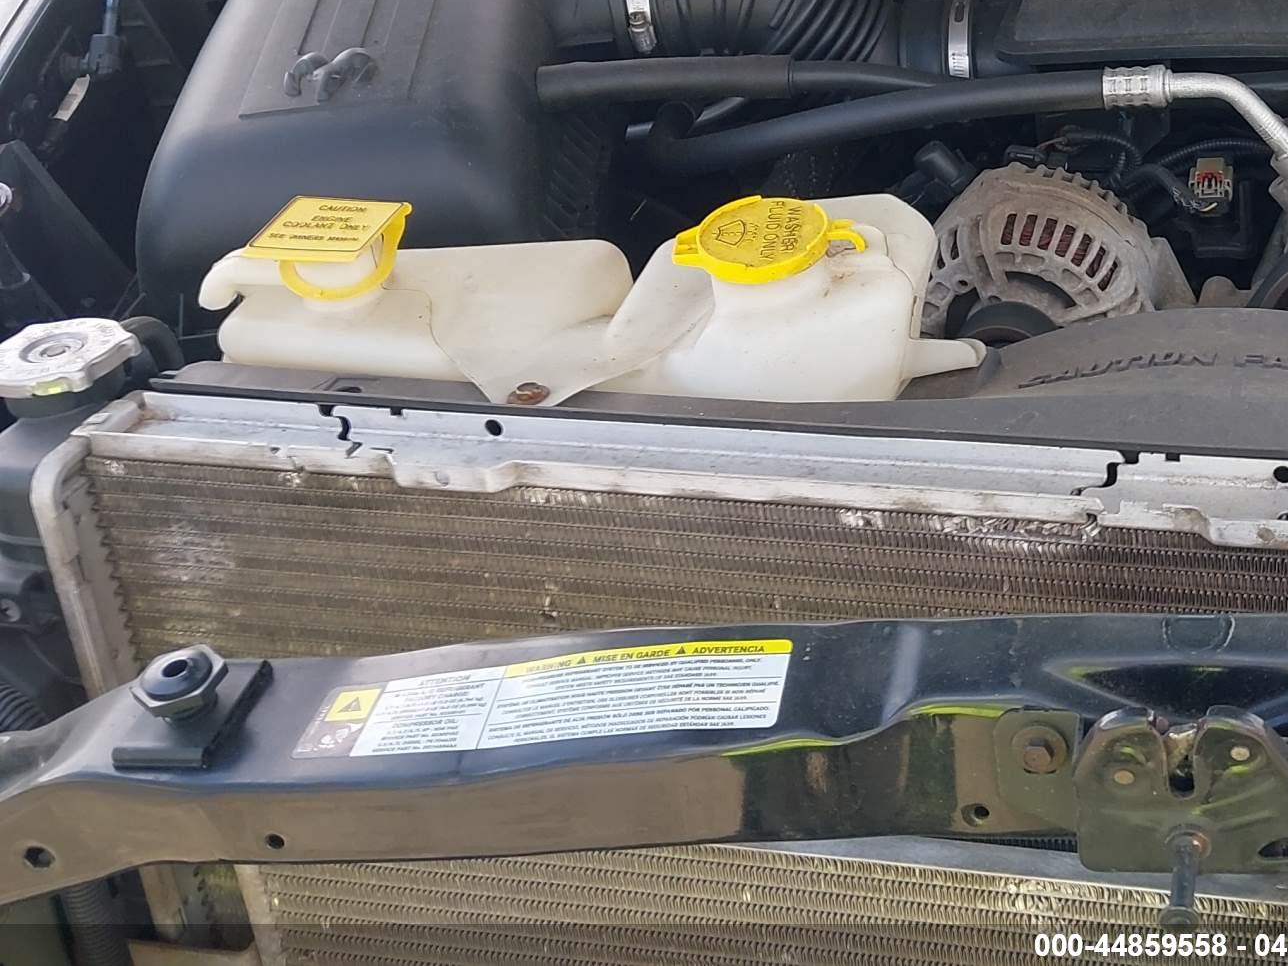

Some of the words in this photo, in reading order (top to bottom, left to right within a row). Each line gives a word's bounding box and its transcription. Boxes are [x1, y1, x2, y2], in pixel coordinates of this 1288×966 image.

[318, 204, 368, 213] CAUTION
[767, 200, 785, 233] FLUID
[282, 220, 334, 229] COOLANT
[780, 206, 801, 254] WASHER
[759, 234, 780, 261] ONLY
[1017, 352, 1218, 389] CAUTION
[526, 659, 571, 673] WARNING
[593, 654, 618, 663] MISE
[620, 652, 634, 661] EN
[635, 649, 670, 660] GARDE
[691, 645, 765, 655] ADVERTENCIA
